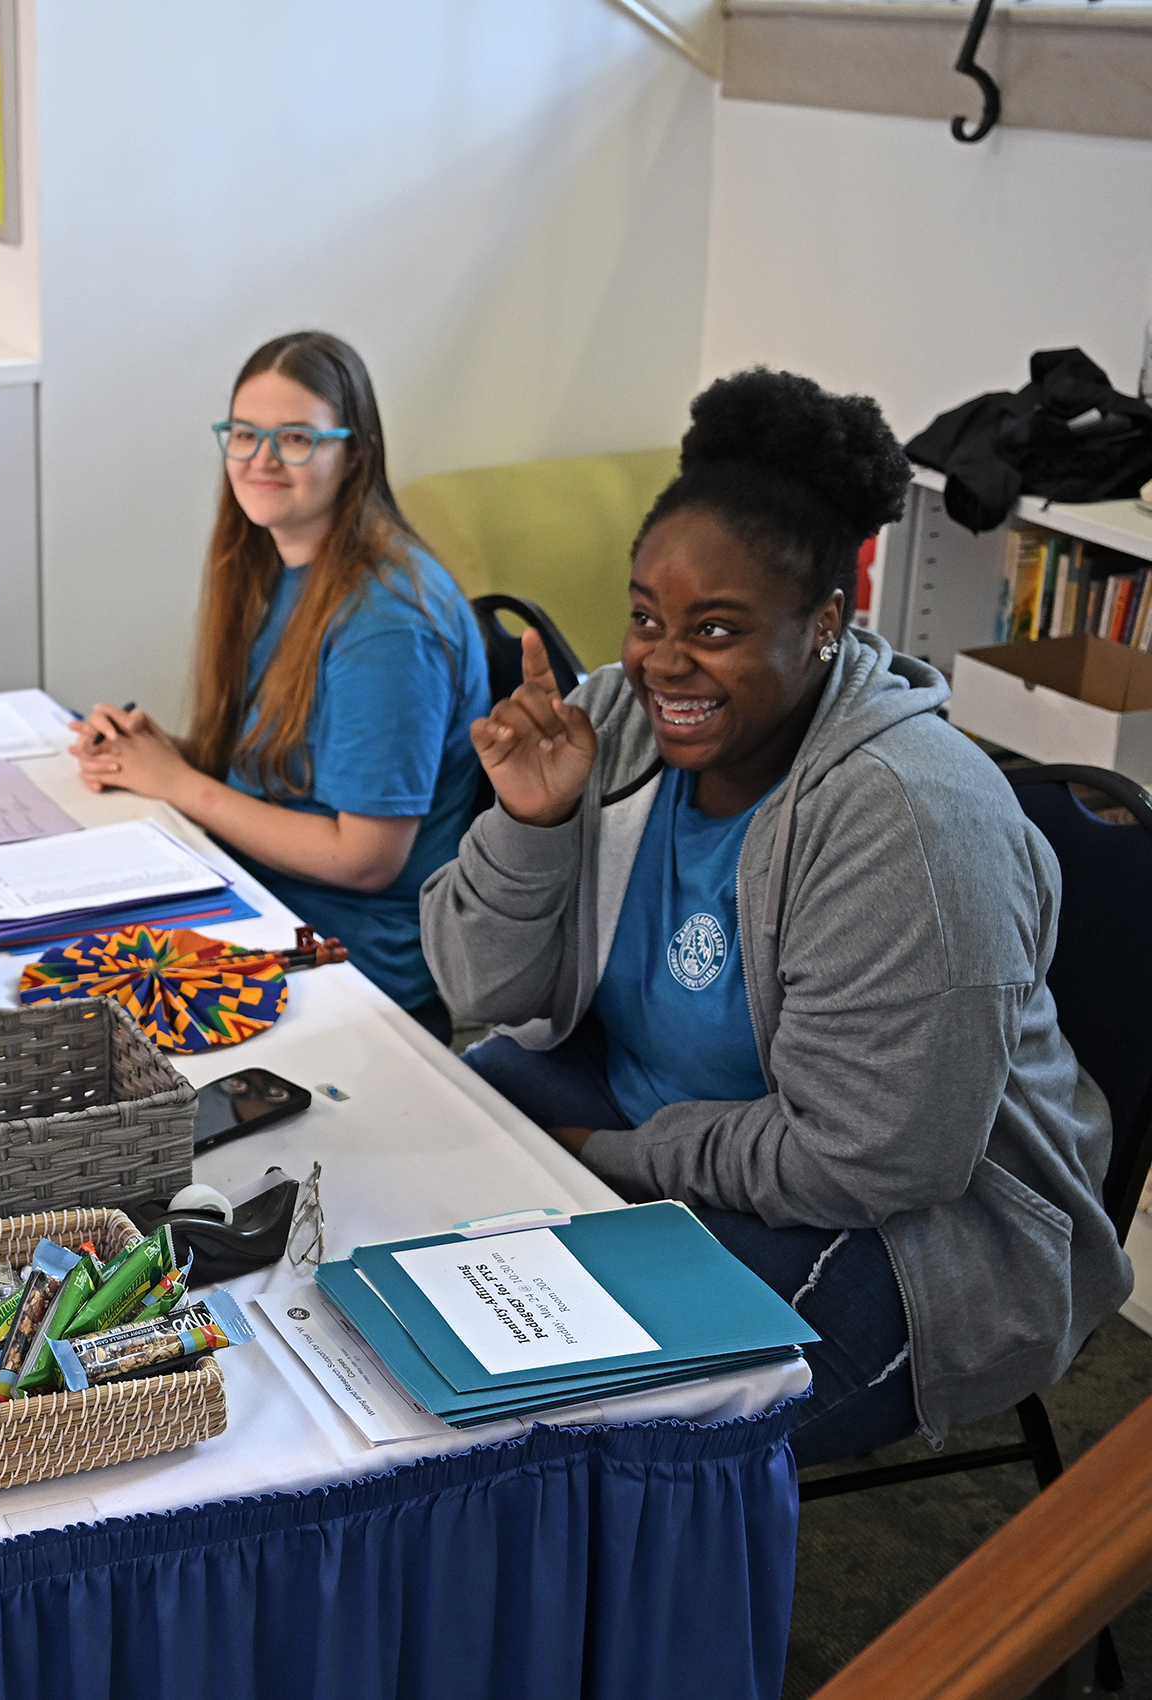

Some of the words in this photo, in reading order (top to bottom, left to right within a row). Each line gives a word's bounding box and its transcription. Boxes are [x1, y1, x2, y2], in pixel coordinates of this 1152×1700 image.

[675, 920, 693, 945] CAMP
[670, 948, 699, 988] CONNECTICUT
[491, 1251, 505, 1264] am
[123, 1268, 151, 1298] VALLEY
[476, 1264, 498, 1282] FYS
[500, 1264, 523, 1284] 10:30
[494, 1282, 510, 1296] for
[518, 1284, 532, 1292] @
[532, 1277, 551, 1292] 203
[457, 1264, 531, 1344] Identity-Affirming
[525, 1293, 540, 1303] 24
[548, 1292, 570, 1313] Room
[172, 1308, 217, 1332] KIND
[507, 1297, 549, 1339] Pedagogy
[536, 1303, 554, 1319] May
[109, 1332, 131, 1343] VANILLA
[303, 1333, 315, 1344] Your
[552, 1319, 578, 1345] Friday,
[316, 1349, 335, 1369] Support
[337, 1358, 355, 1379] Courses
[332, 1369, 354, 1392] Research
[350, 1390, 362, 1401] and
